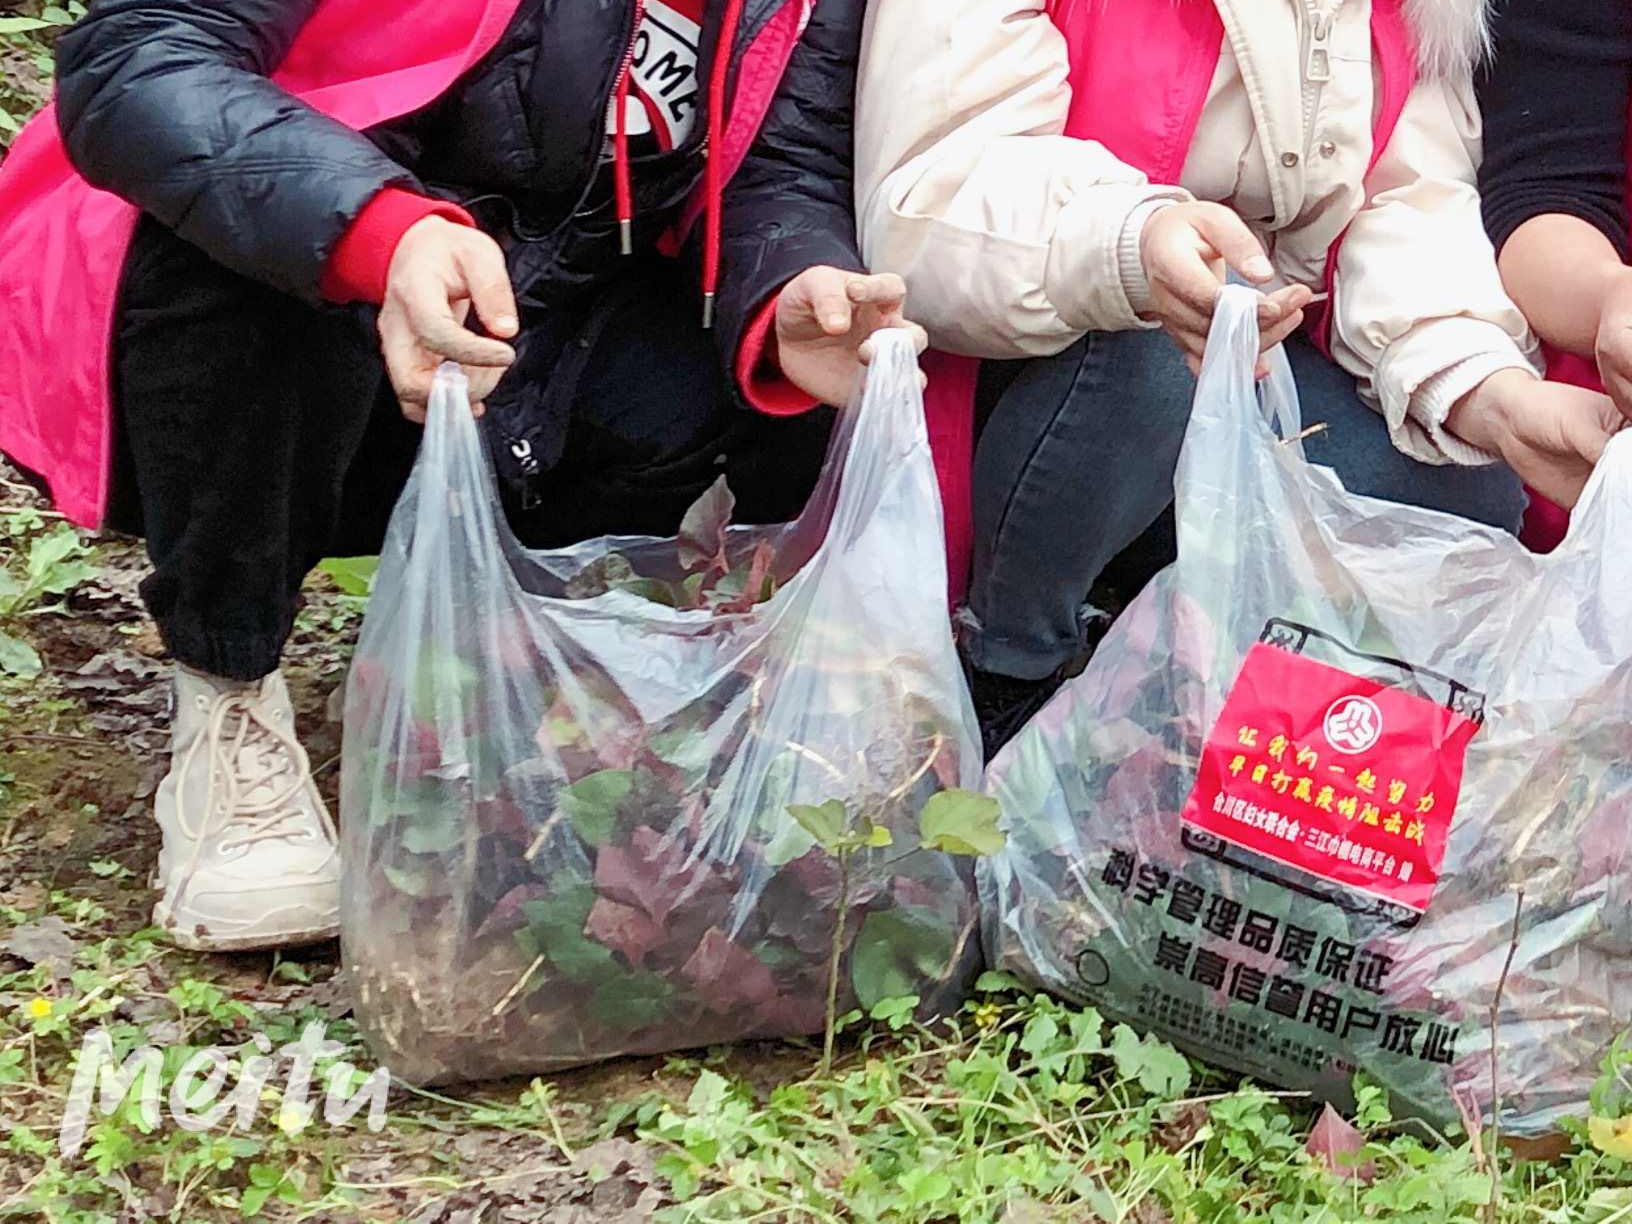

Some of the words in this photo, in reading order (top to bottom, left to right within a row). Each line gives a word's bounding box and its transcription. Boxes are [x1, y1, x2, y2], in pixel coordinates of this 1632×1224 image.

[1228, 754, 1426, 846] 早日打赢疫情阻击战
[1237, 725, 1436, 815] 让我们一起努力
[1100, 848, 1394, 996] 科学管理品质保证
[1153, 931, 1460, 1064] 崇高信誉用户放心
